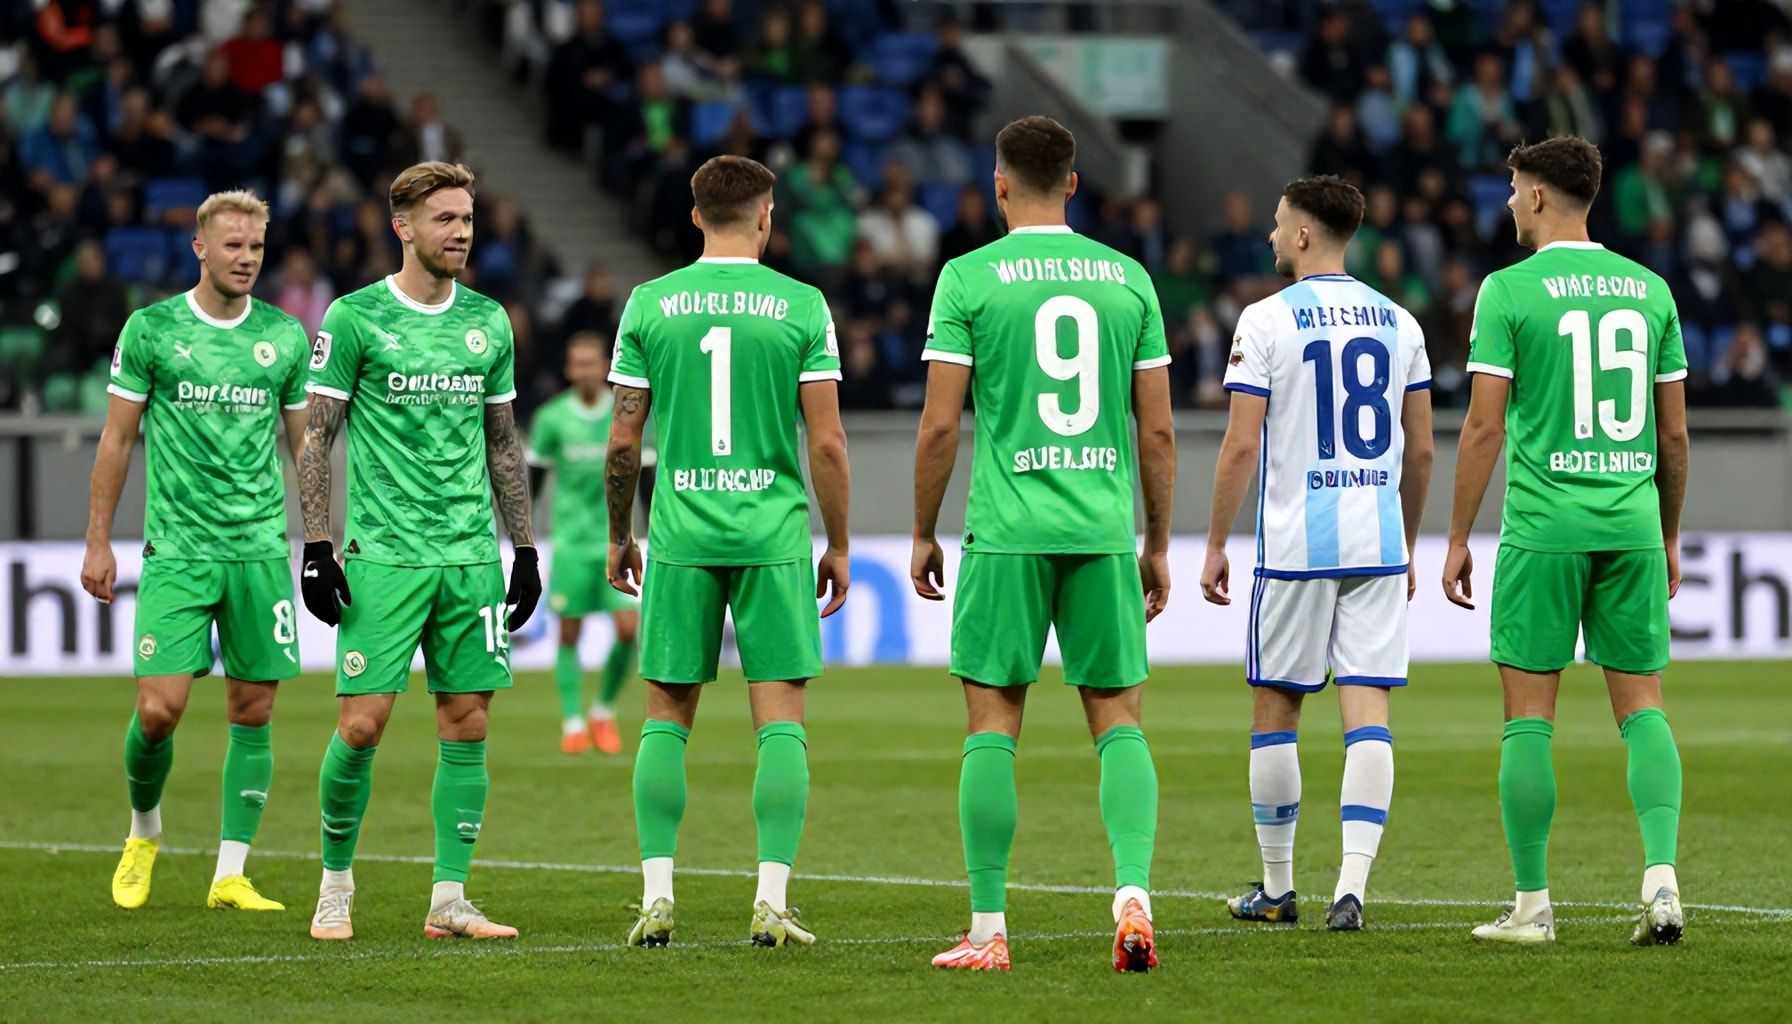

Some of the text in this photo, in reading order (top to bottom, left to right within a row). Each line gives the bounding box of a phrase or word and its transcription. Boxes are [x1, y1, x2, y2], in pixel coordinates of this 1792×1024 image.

[700, 326, 732, 456] 1
[1034, 295, 1100, 437] 9
[1303, 336, 1392, 460] 18
[273, 600, 296, 644] 8
